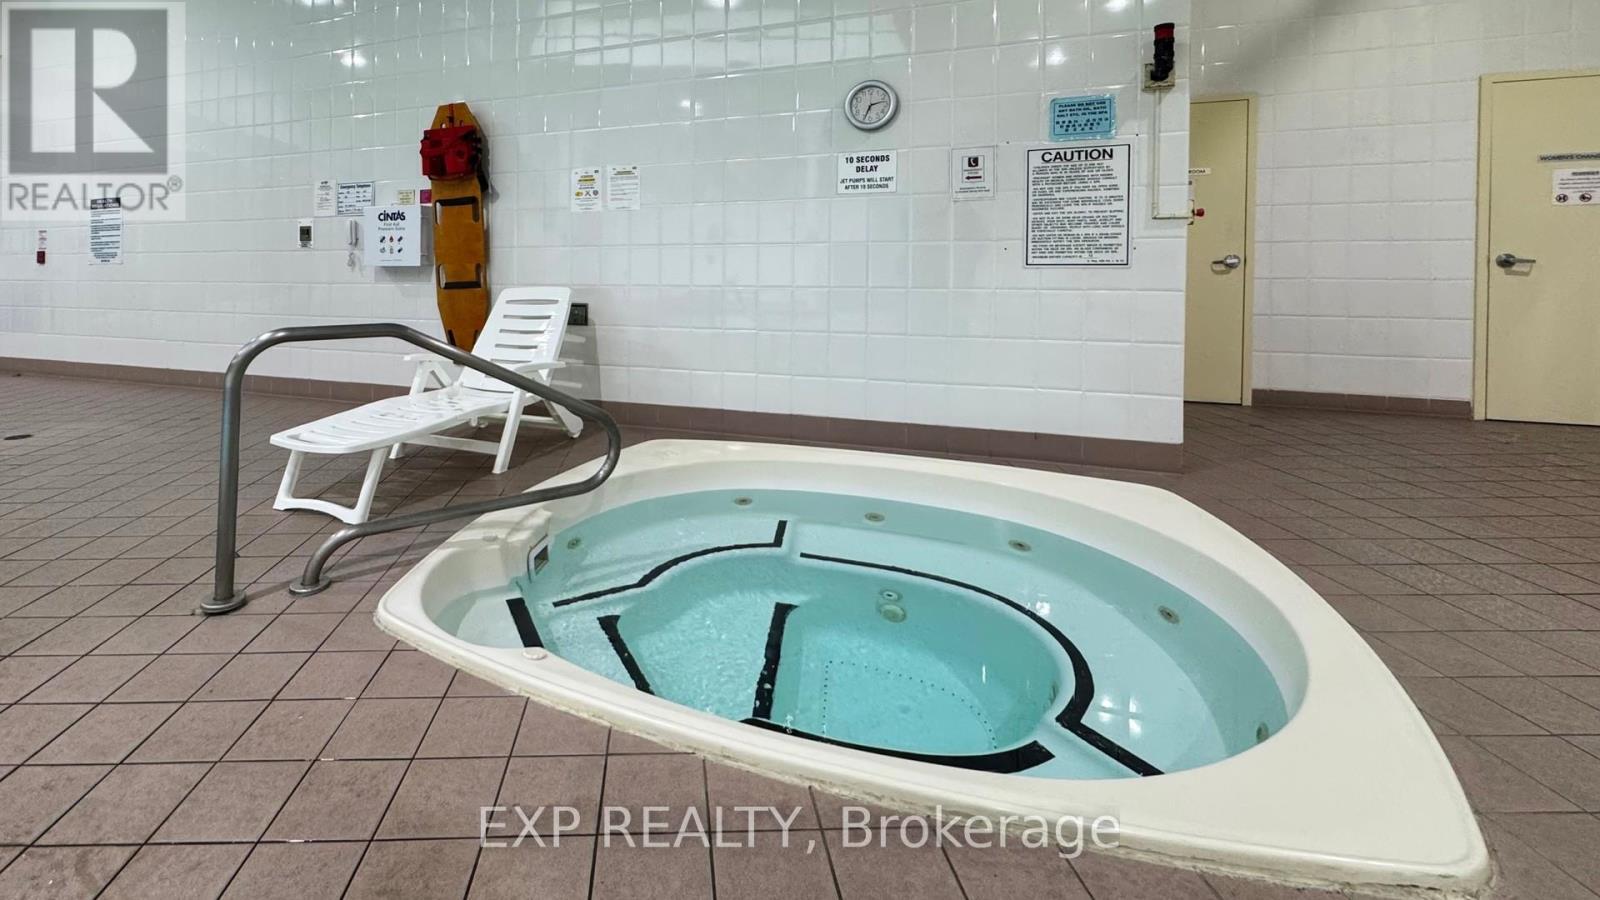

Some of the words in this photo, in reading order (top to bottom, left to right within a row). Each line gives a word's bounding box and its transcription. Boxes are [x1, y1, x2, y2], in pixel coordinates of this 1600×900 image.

[845, 156, 854, 164] 10
[855, 154, 890, 164] SECONDS
[1041, 147, 1114, 163] CAUTION
[855, 164, 879, 173] DELAY
